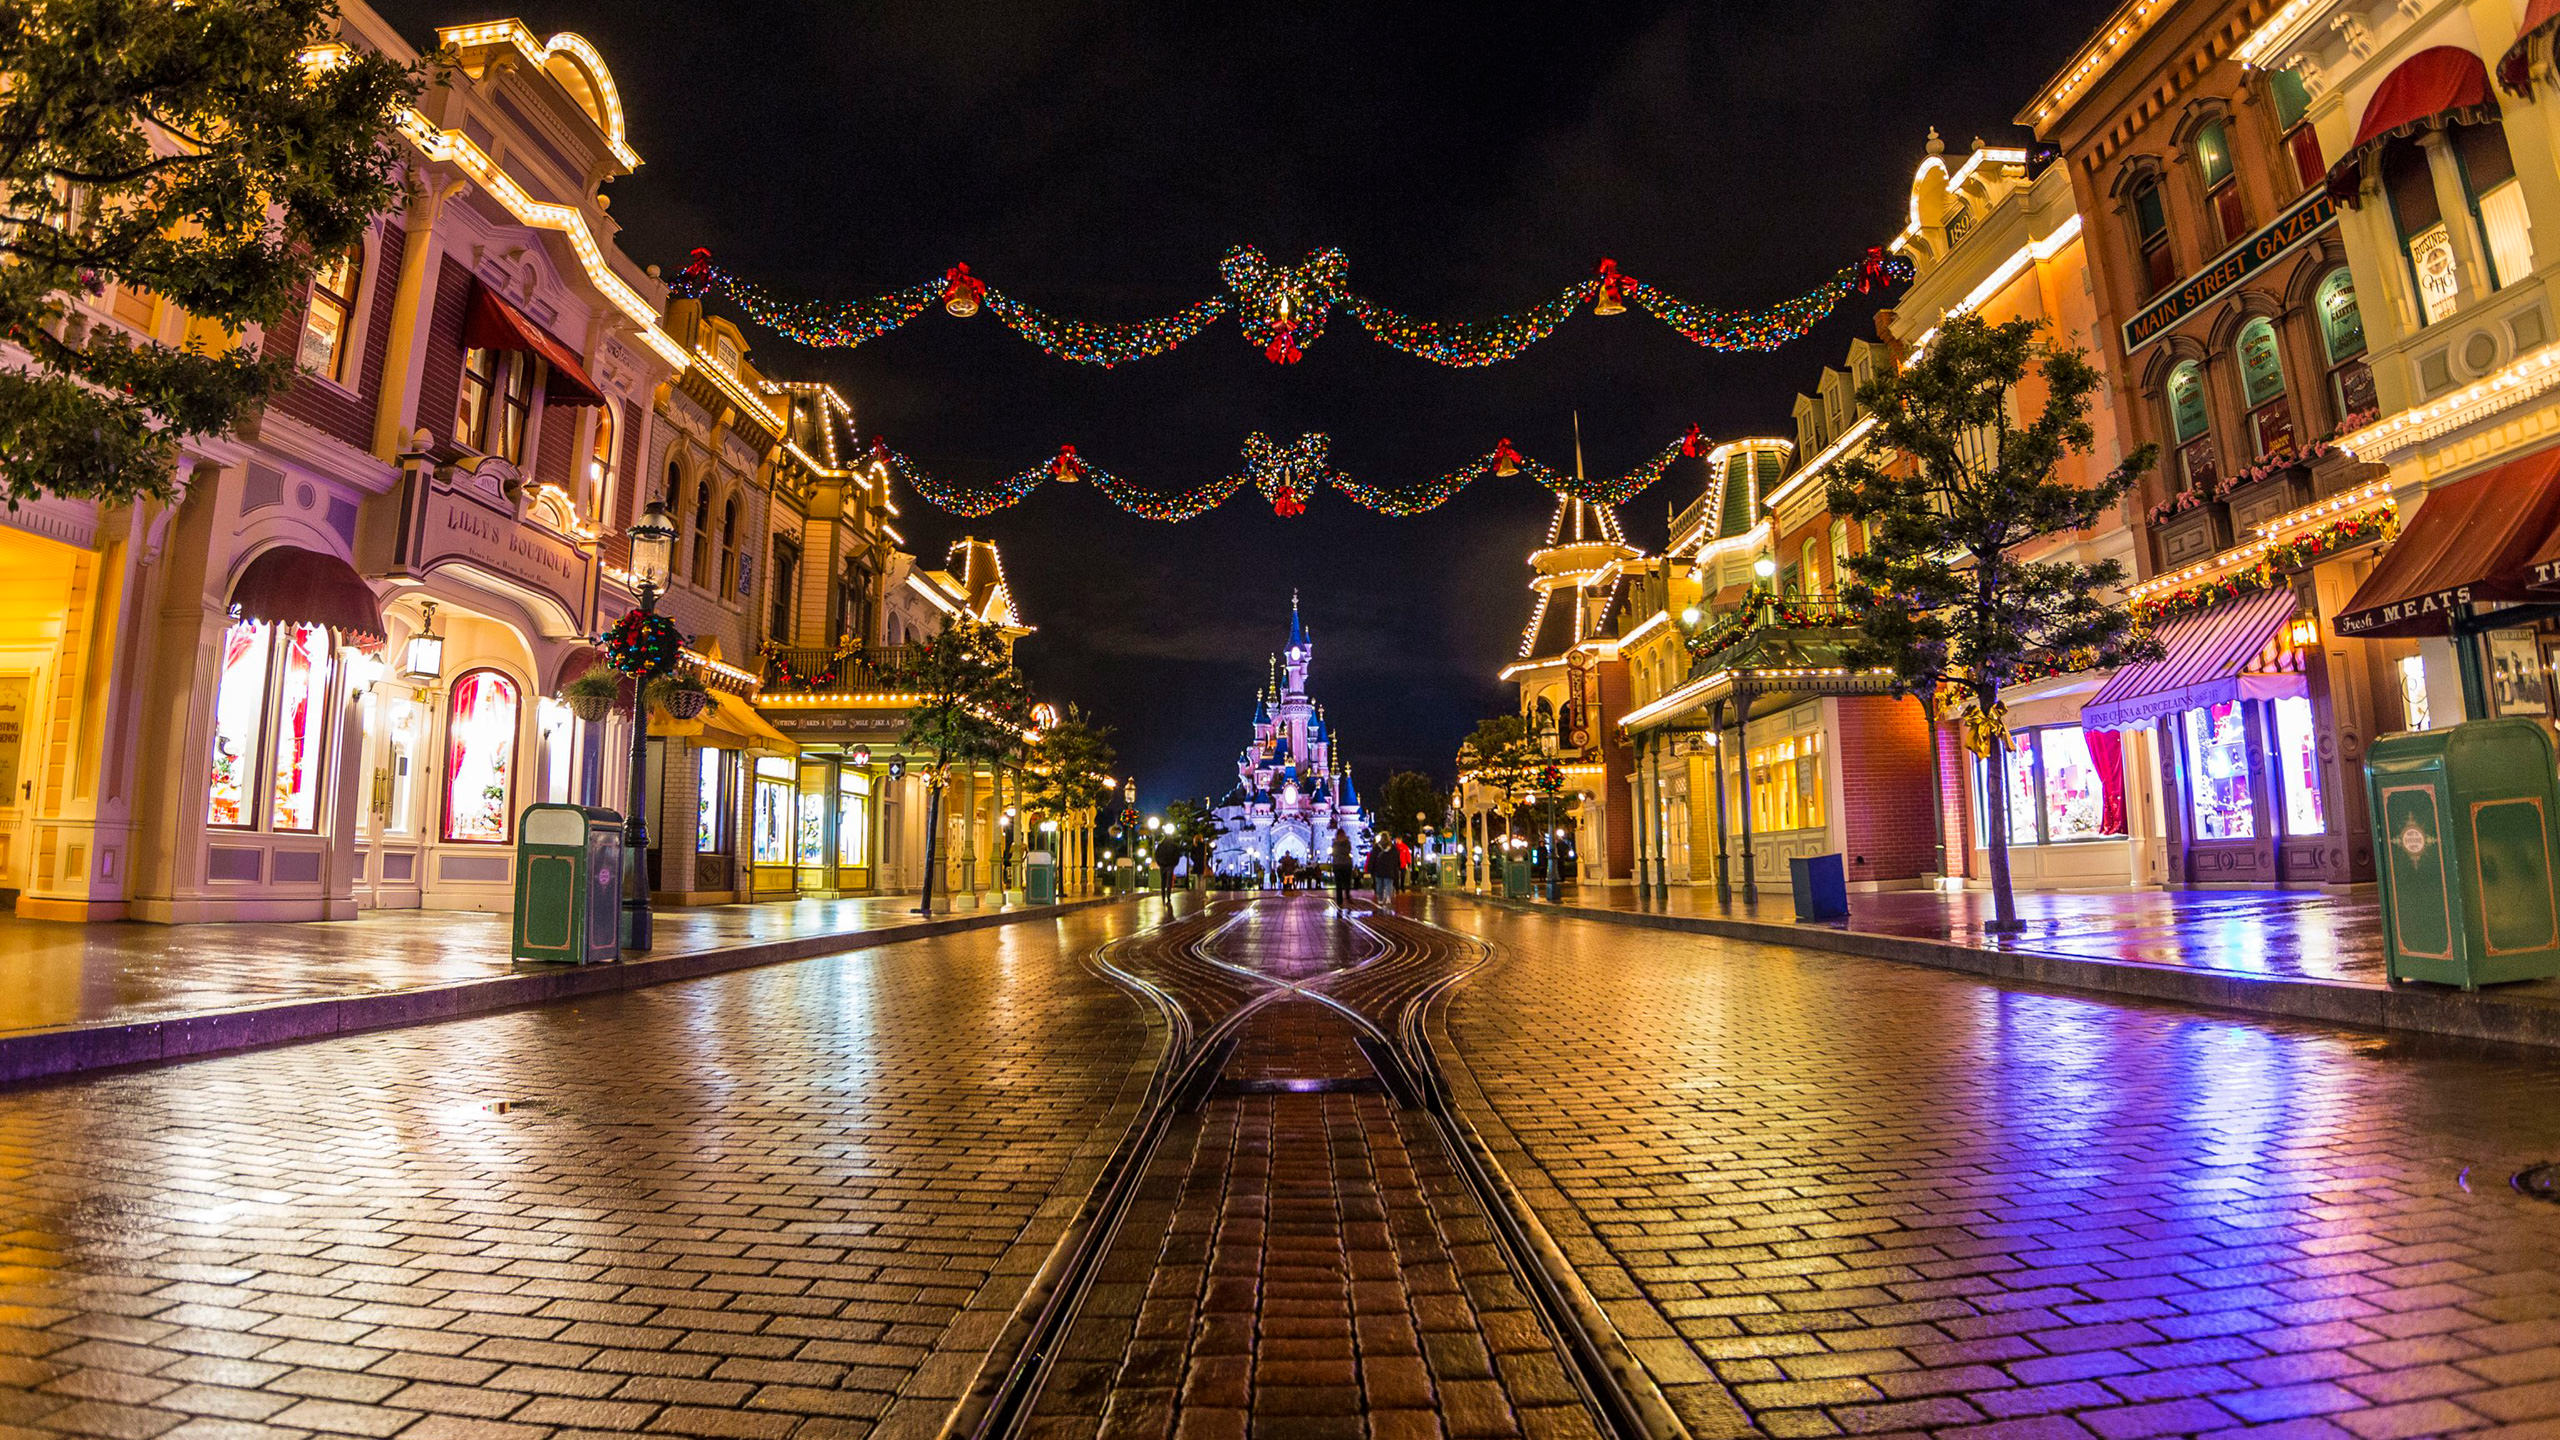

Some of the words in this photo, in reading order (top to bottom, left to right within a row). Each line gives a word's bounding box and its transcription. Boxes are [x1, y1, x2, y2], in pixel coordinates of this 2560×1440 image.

[2134, 300, 2179, 342] MAIN
[2184, 252, 2249, 308] STREET
[509, 532, 571, 579] BOUTIQUE
[2342, 612, 2374, 632] Fresh
[2383, 586, 2471, 624] MEATS
[2090, 711, 2109, 724] FINE
[2109, 707, 2135, 722] CHINA
[2135, 707, 2142, 716] &
[2143, 696, 2193, 715] PORCELAINS
